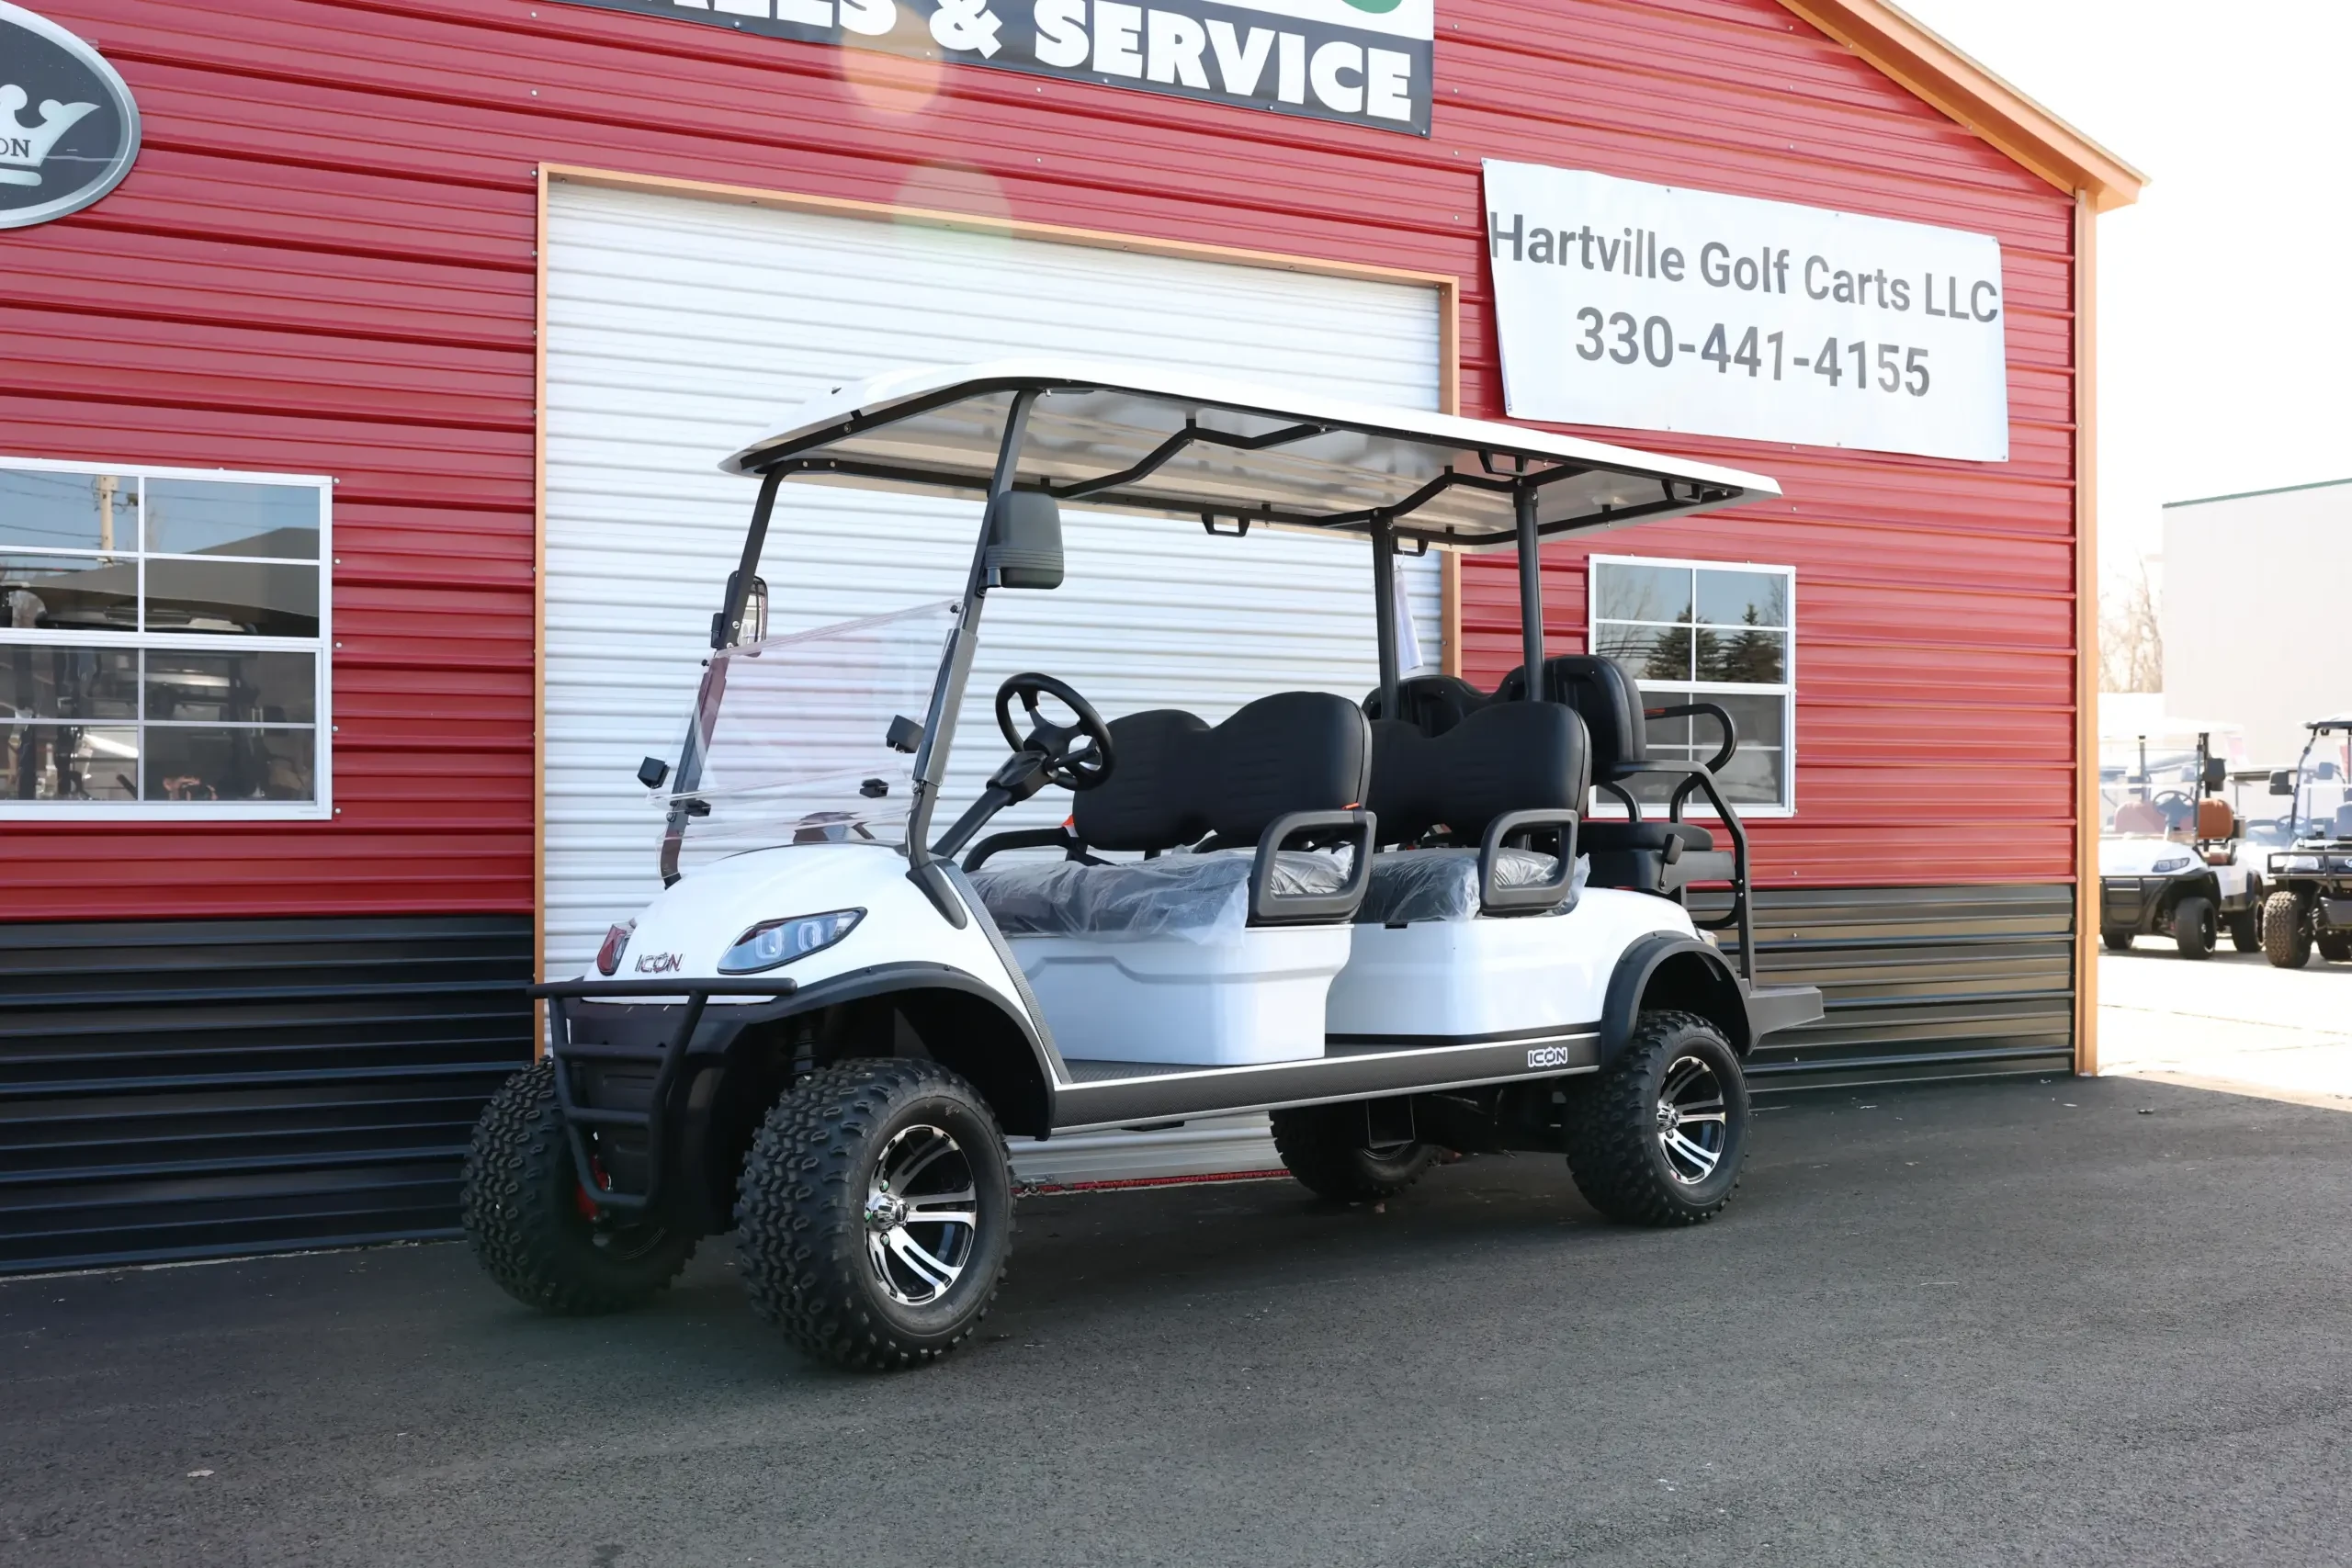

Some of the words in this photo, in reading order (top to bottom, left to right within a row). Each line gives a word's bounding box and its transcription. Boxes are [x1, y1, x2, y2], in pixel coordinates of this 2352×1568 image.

[1033, 0, 1411, 121] SERVICE
[1489, 211, 1685, 282] Hartville
[1700, 242, 1790, 294] Golf
[1804, 255, 1911, 311] Carts
[1925, 273, 1998, 322] LLC
[1575, 307, 1930, 397] 330-441-4155
[635, 953, 684, 974] ICON
[1528, 1046, 1568, 1067] ICON
